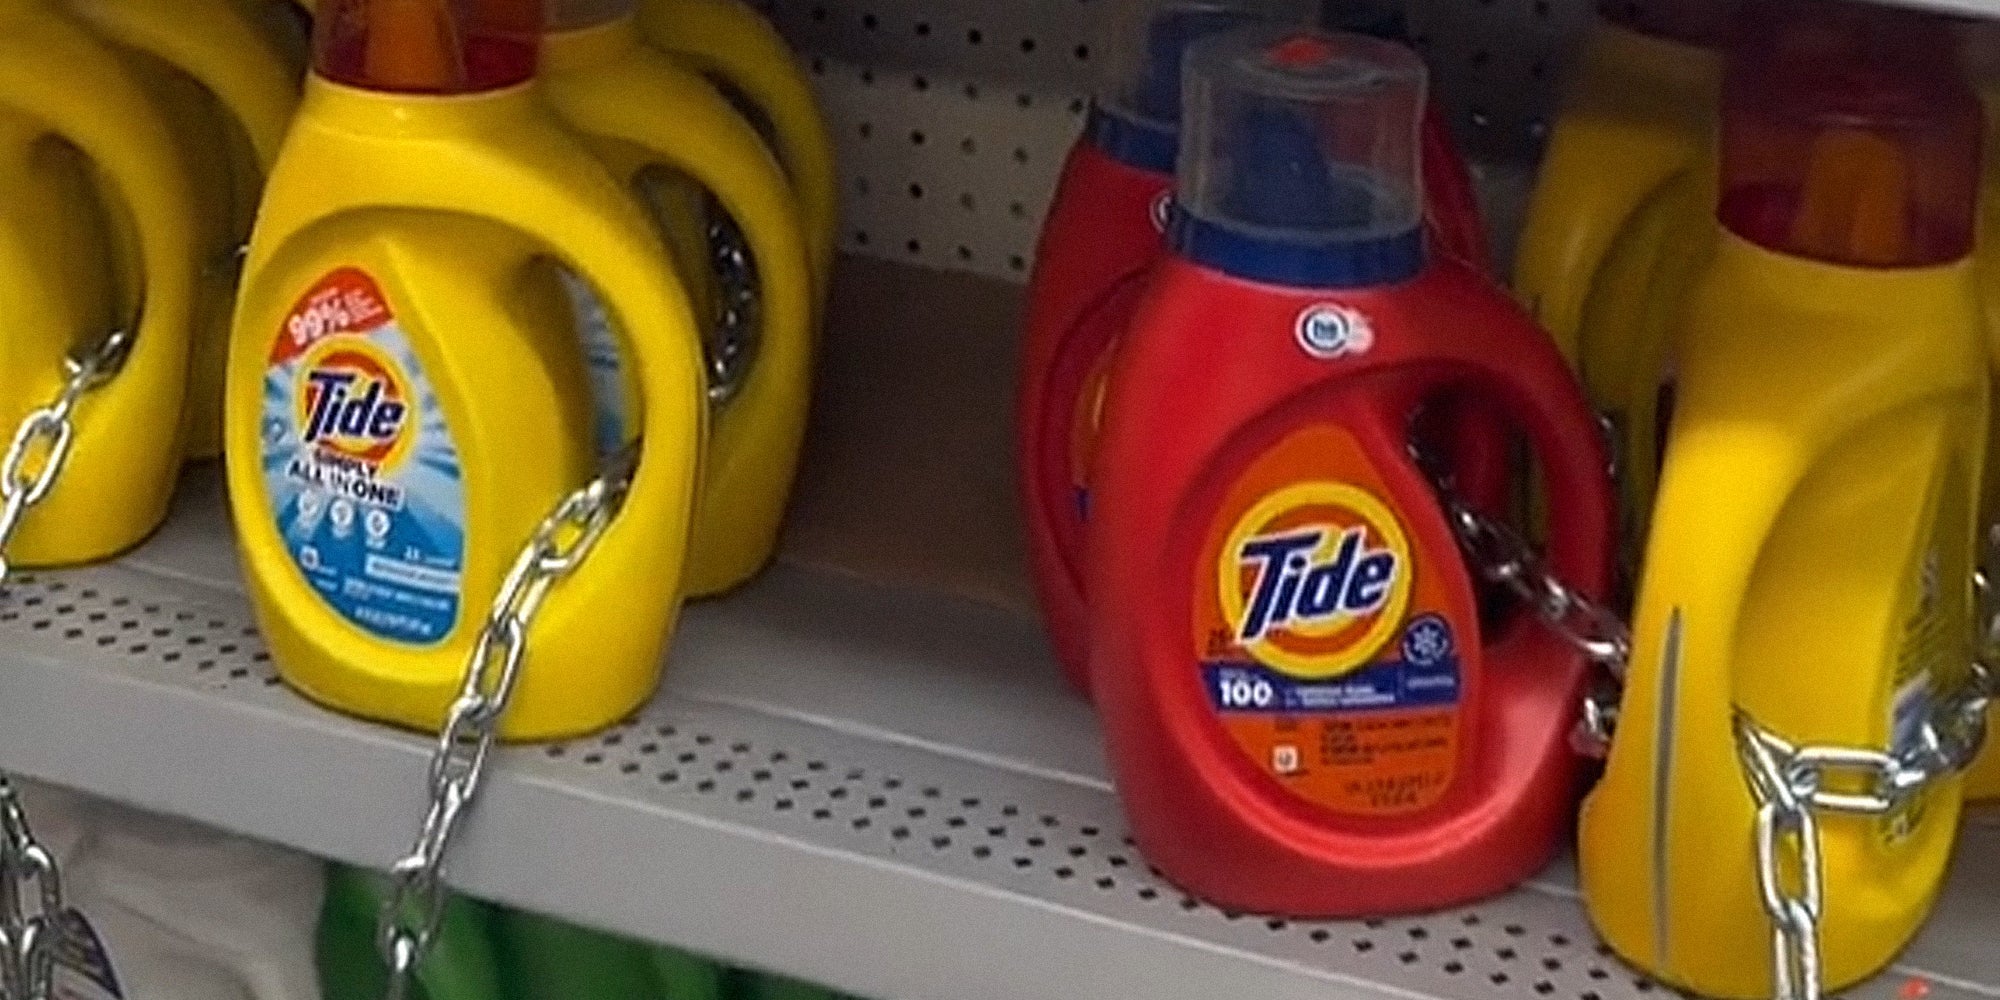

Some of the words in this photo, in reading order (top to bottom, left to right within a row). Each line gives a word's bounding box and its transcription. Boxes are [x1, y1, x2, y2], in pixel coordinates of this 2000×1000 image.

[305, 370, 405, 443] Tide
[352, 480, 400, 507] ONE
[1239, 529, 1396, 641] Tide
[1219, 679, 1274, 708] 100
